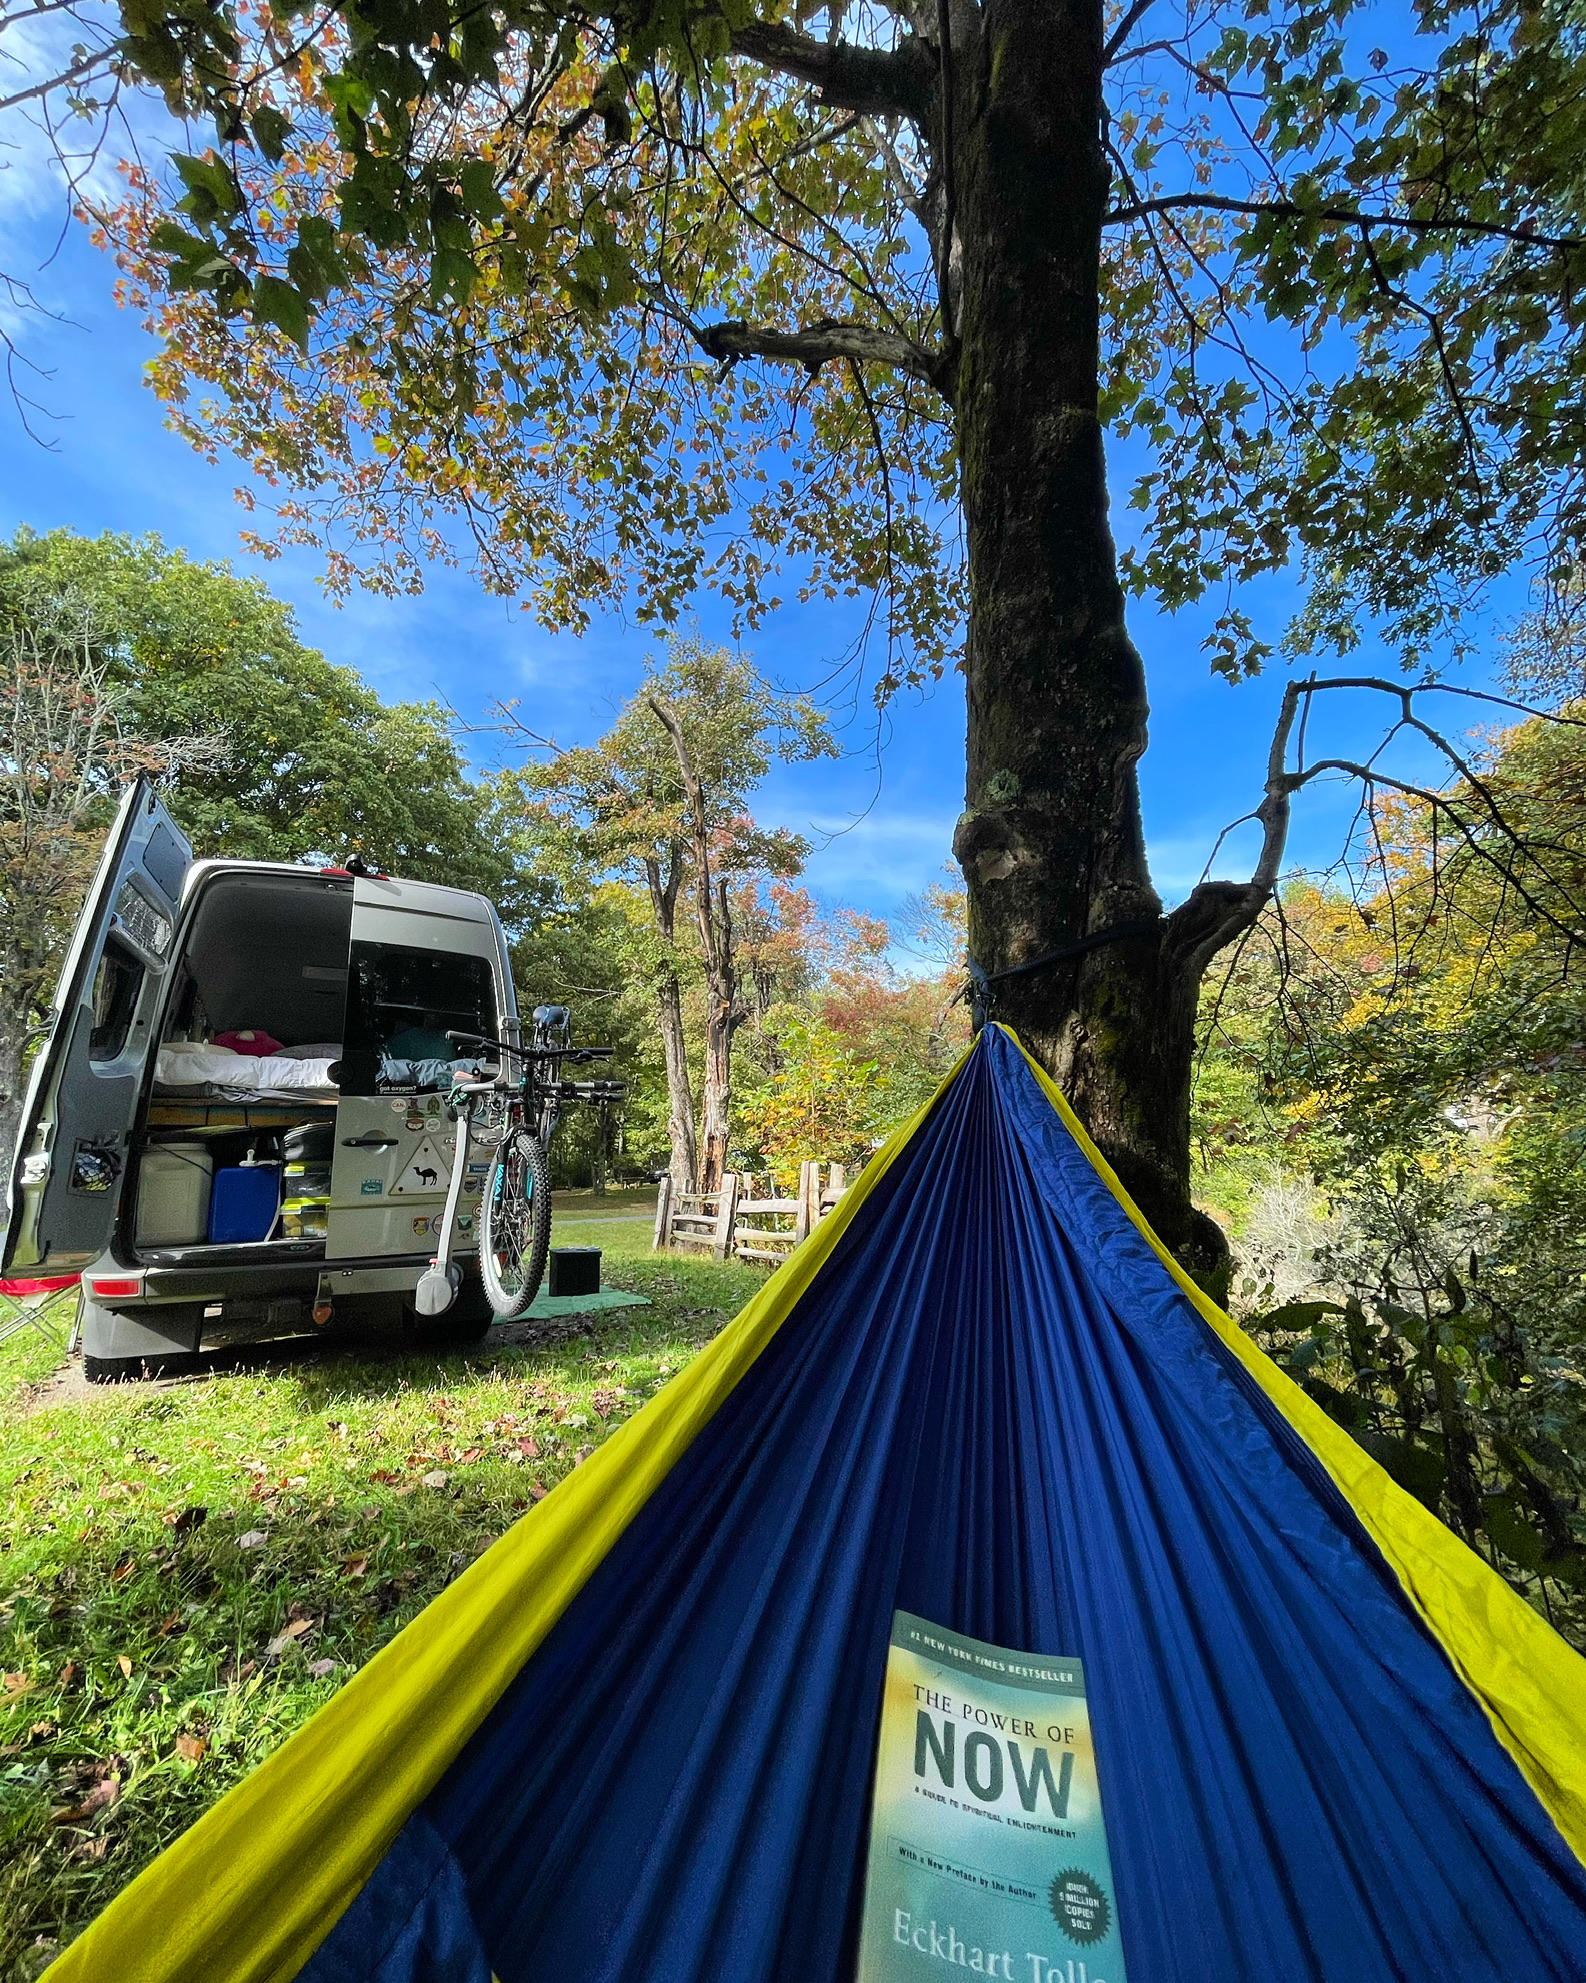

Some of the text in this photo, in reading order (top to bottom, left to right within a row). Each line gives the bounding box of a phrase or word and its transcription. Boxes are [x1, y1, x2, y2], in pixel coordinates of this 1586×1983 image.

[924, 1636, 946, 1651] NEW
[948, 1645, 972, 1662] YORK
[975, 1655, 1006, 1672] TIMES
[1008, 1664, 1073, 1683] BESTSELLER
[913, 1683, 1074, 1745] THE POWER OF
[914, 1708, 1075, 1819] NOW
[1007, 1817, 1076, 1839] ENLIGHTENMENT
[899, 1846, 1037, 1899] With a New Preface by the Author
[1064, 1904, 1095, 1919] COPIES
[1065, 1893, 1100, 1908] MILLION
[1071, 1918, 1092, 1930] SOLD
[893, 1907, 1106, 1983] Eckhart Toll
